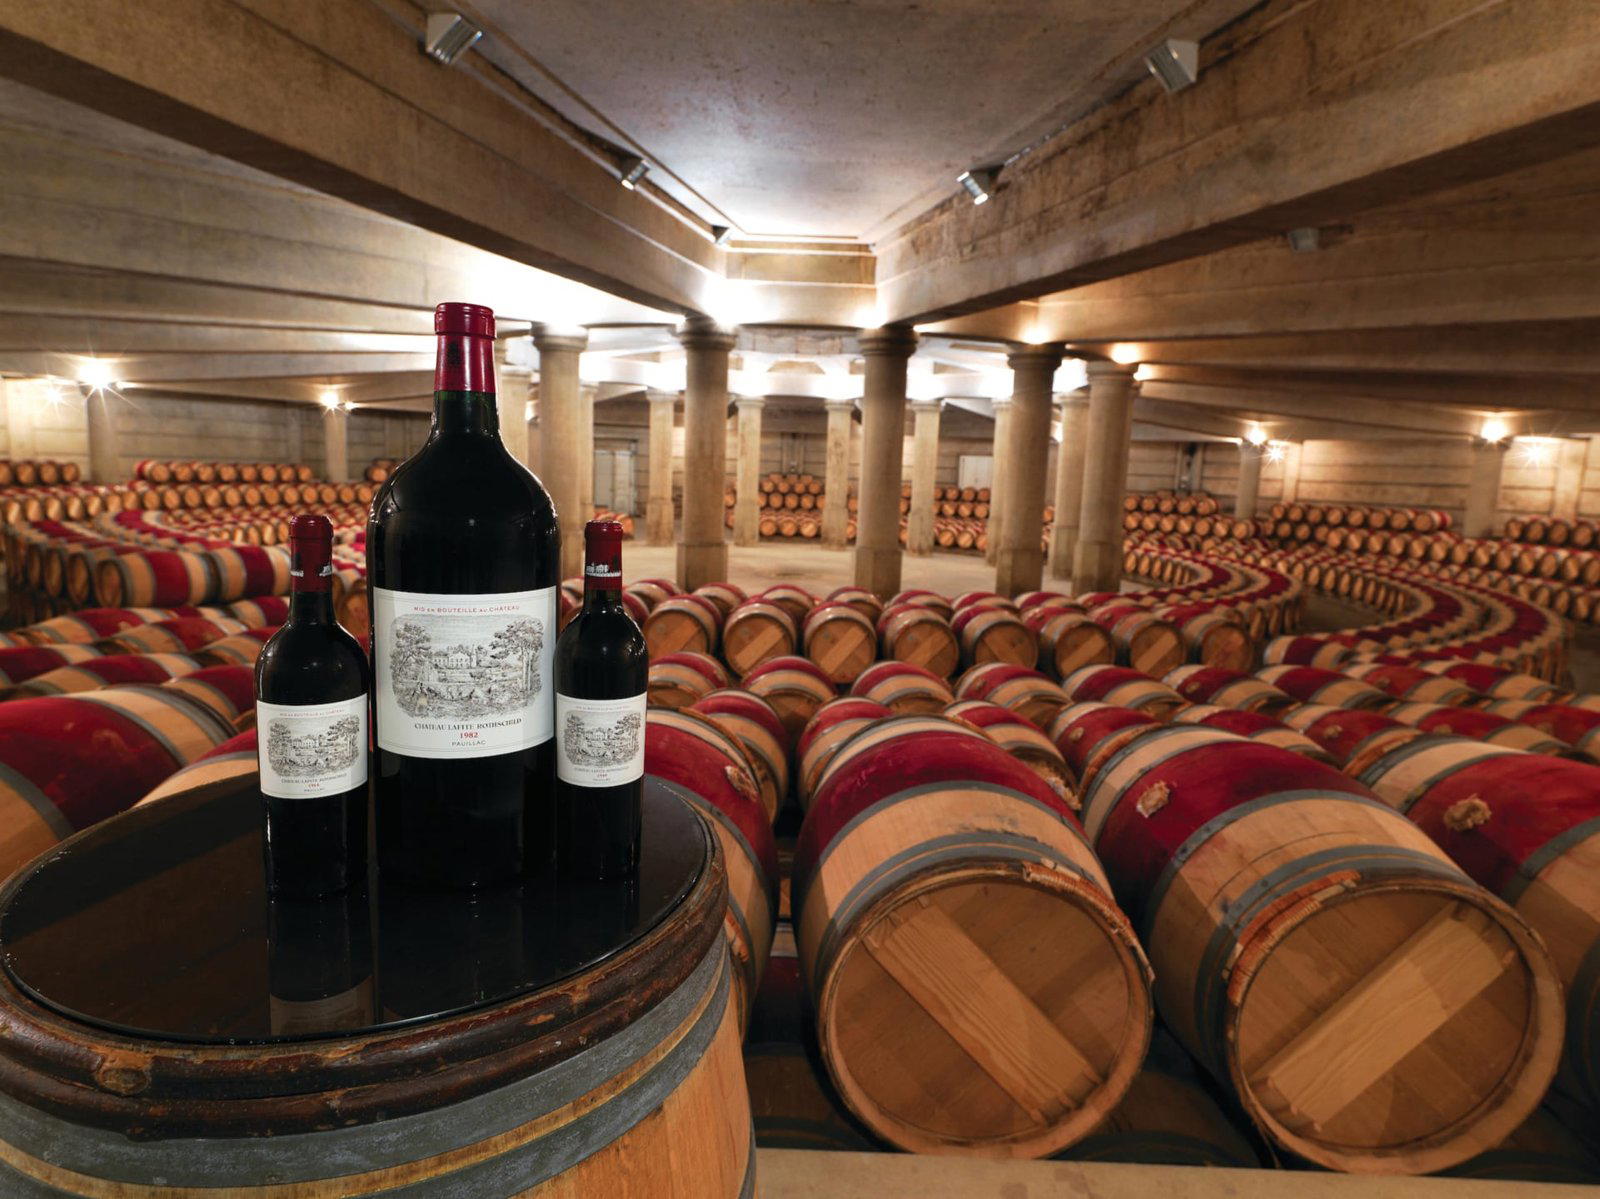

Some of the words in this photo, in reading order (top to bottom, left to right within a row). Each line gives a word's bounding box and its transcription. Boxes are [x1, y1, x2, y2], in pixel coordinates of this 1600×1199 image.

[448, 723, 473, 731] LAFITE
[476, 718, 522, 730] ROTHSCHILD
[451, 739, 487, 747] PAUILLAC
